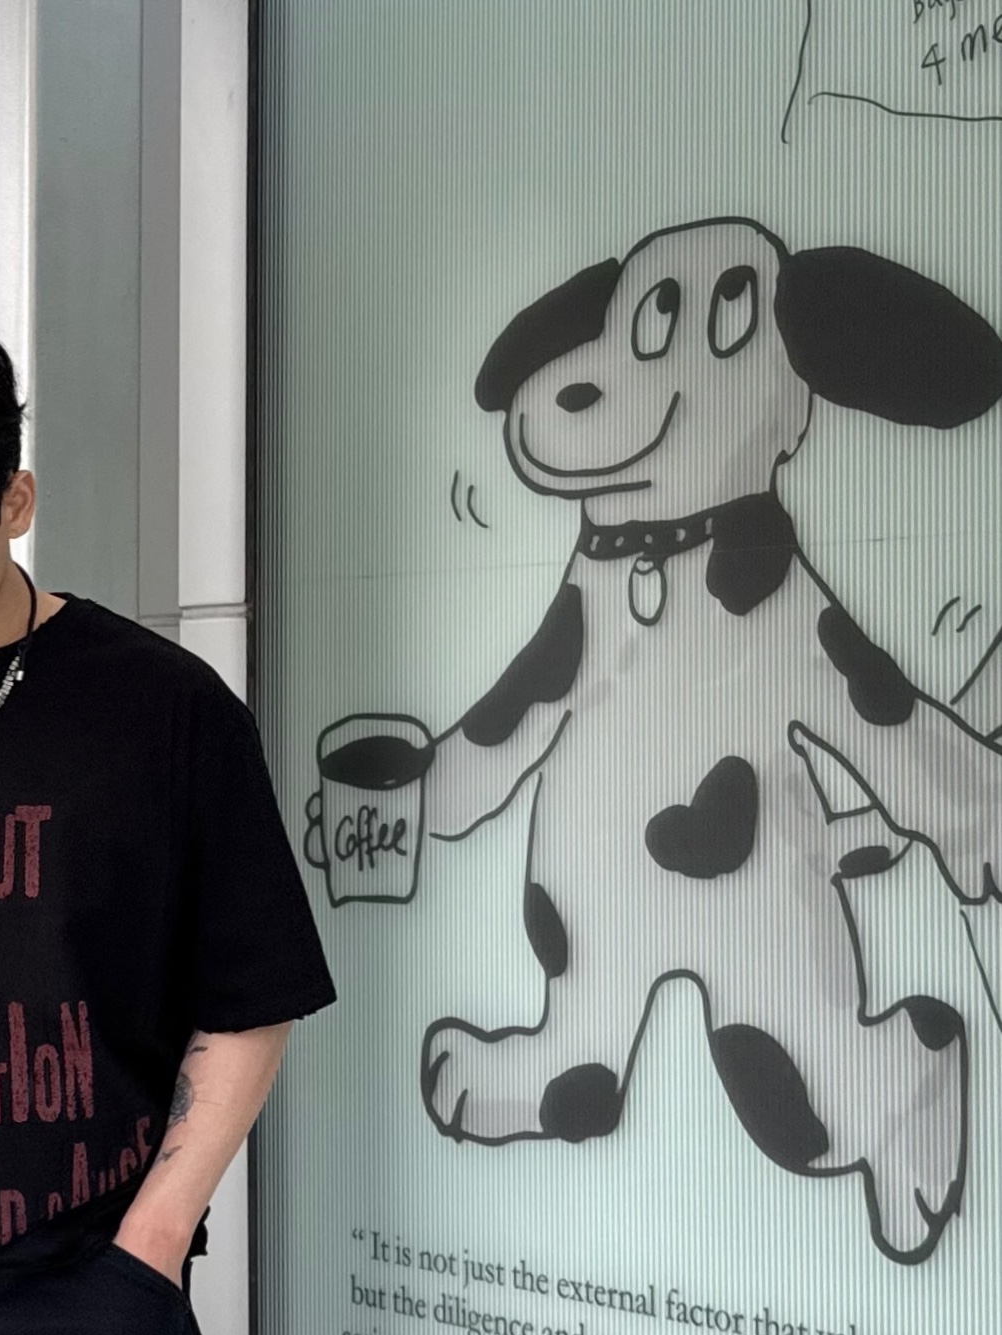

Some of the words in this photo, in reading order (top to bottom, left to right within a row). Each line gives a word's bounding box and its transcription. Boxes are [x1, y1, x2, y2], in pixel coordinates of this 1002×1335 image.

[921, 43, 946, 85] 4
[334, 805, 407, 872] Coffee
[350, 1274, 386, 1311] but
[393, 1285, 427, 1319] the
[395, 1235, 412, 1267] is
[418, 1249, 457, 1277] not
[462, 1248, 505, 1290] just
[512, 1259, 550, 1295] the
[557, 1275, 657, 1318] external
[666, 1288, 744, 1335] factor
